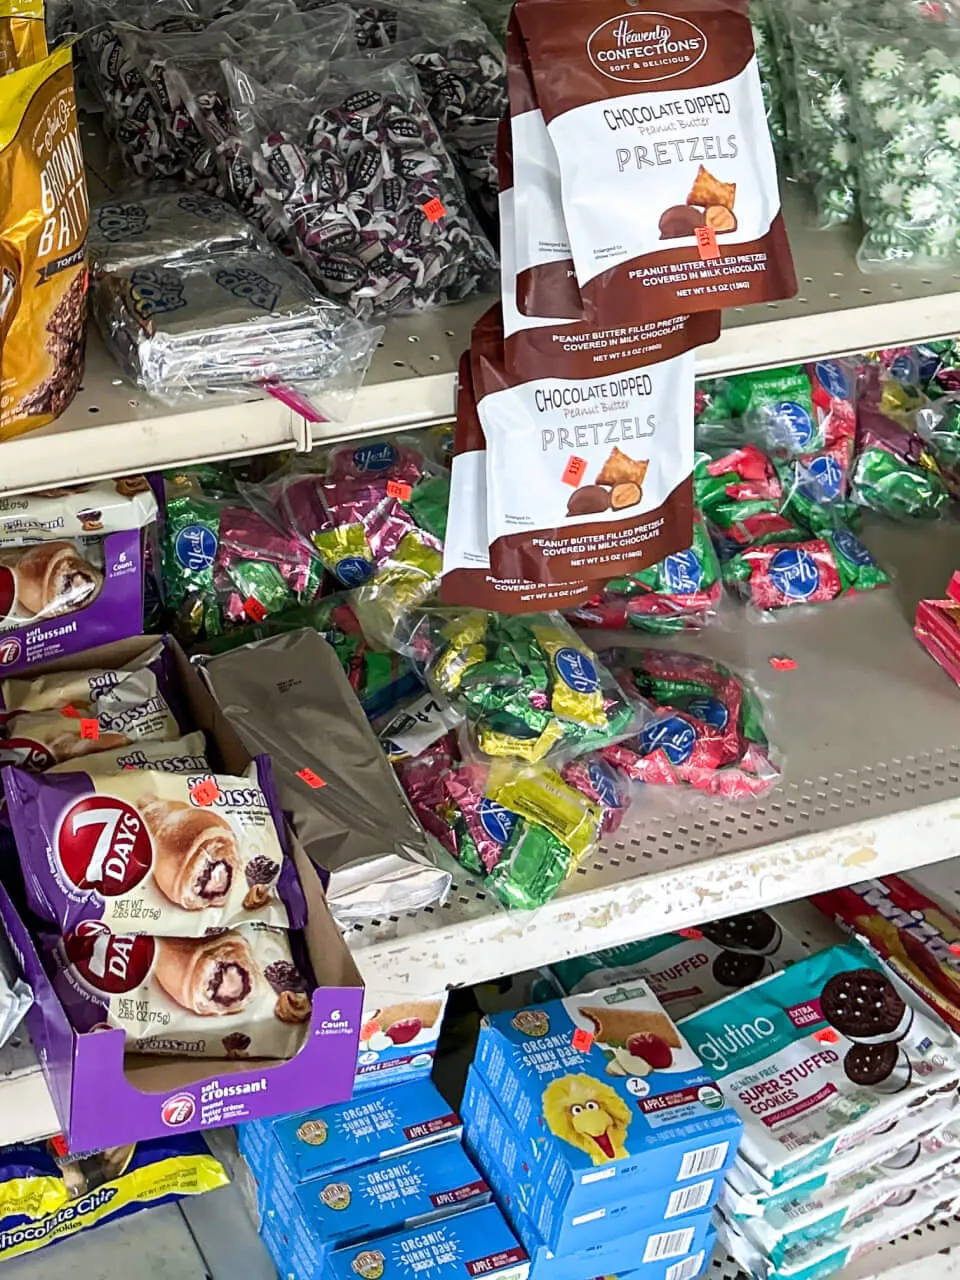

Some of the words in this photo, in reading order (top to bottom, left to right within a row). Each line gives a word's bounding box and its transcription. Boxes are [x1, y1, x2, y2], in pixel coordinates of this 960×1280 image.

[613, 20, 672, 48] Heavenly
[596, 37, 701, 63] CONFECTIONS
[609, 62, 632, 73] SOFT
[642, 55, 691, 69] DELICIOUS
[602, 102, 684, 132] CHOCOLATE
[684, 91, 732, 117] DIPPED
[639, 121, 678, 136] Peanut
[678, 116, 711, 131] Butter
[615, 134, 739, 173] PRETZELS
[628, 267, 670, 280] PEANUT
[670, 261, 706, 275] BUTTER
[707, 256, 737, 269] FILLED
[642, 275, 688, 288] COVERED
[700, 269, 722, 280] MILK
[722, 262, 767, 277] CHOCOLATE
[534, 384, 608, 413] CHOCOLATE
[609, 373, 653, 399] DIPPED
[562, 404, 600, 420] Peanut
[600, 399, 630, 414] Butter
[540, 414, 657, 452] PRETZELS
[112, 559, 133, 571] Count
[26, 621, 78, 644] croissant
[72, 808, 123, 883] 7
[104, 812, 142, 883] DAYS
[113, 899, 130, 909] NET
[131, 899, 144, 908] WT
[788, 1005, 816, 1022] EXTRA
[697, 1014, 776, 1072] glutino
[738, 1073, 782, 1105] SUPER
[781, 1048, 841, 1085] STUFFED
[200, 1078, 268, 1104] croissant
[749, 1088, 800, 1117] COOKIES
[642, 1098, 666, 1113] APPLE
[408, 1126, 429, 1139] APPLE
[77, 1186, 117, 1214] Chip
